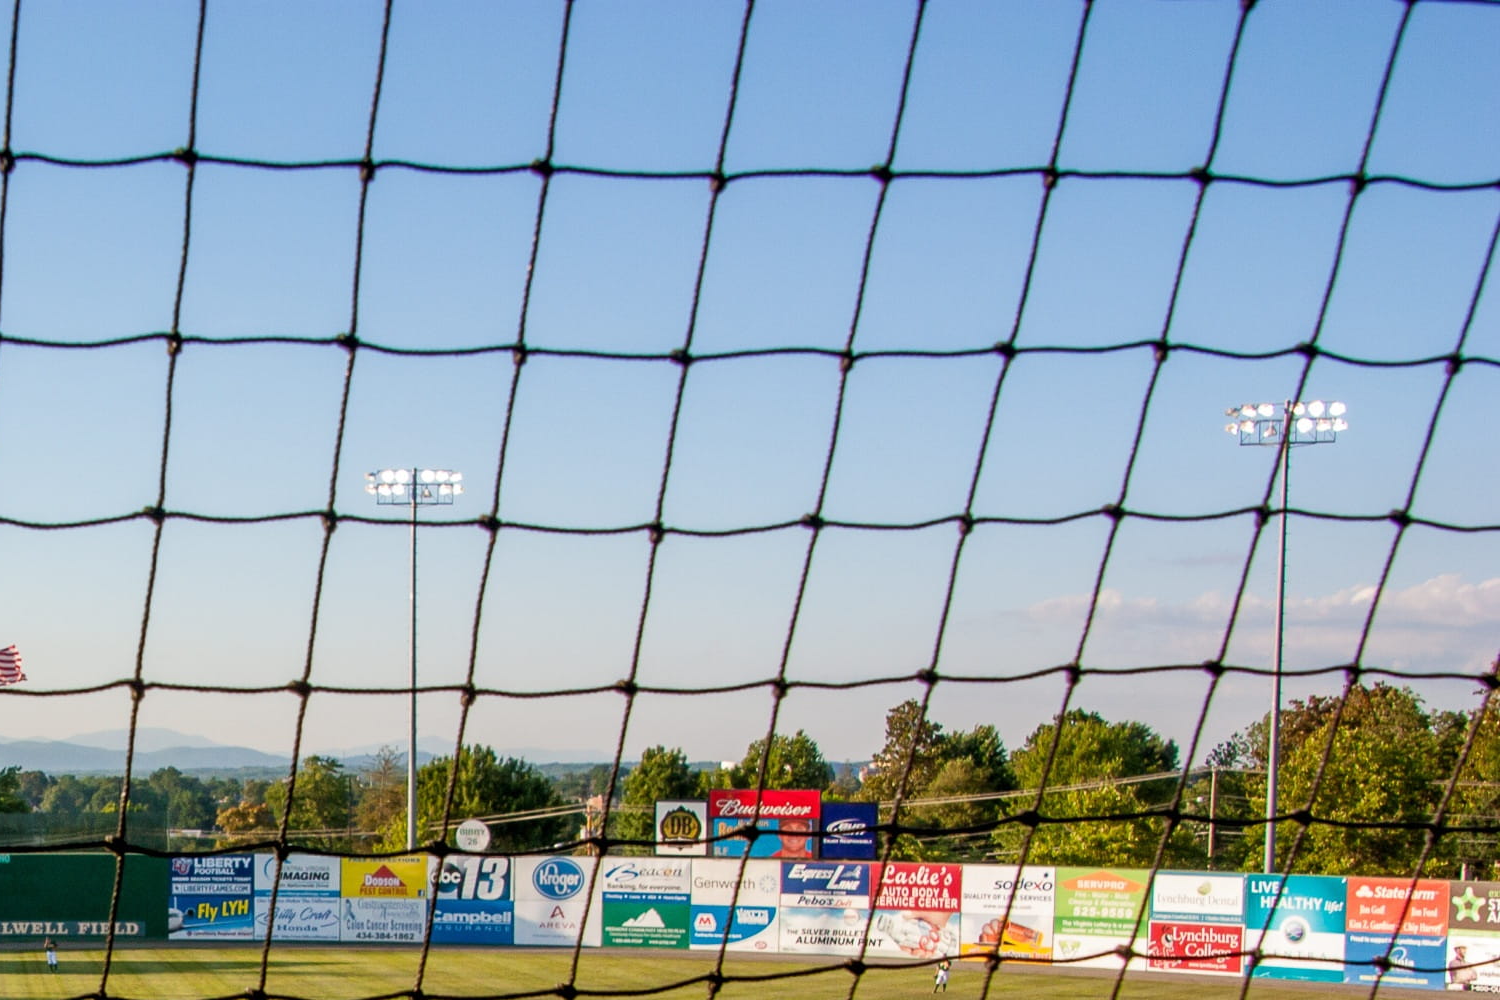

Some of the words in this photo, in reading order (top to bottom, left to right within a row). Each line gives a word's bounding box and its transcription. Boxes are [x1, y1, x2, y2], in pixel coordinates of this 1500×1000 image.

[715, 799, 812, 817] Budweiser
[669, 815, 694, 835] DB
[194, 857, 252, 869] LIBERTY
[194, 868, 235, 876] FOOTBALL
[461, 856, 509, 901] 13
[539, 863, 580, 895] Kroger
[882, 865, 953, 887] Laslie's
[694, 877, 756, 889] Genwoth
[1077, 879, 1126, 890] SERVPRO
[1251, 880, 1280, 894] LIVE
[881, 886, 910, 898] AUTO
[911, 887, 940, 899] BODY
[918, 897, 958, 909] CENTER
[1157, 894, 1205, 907] Lynchburg
[1208, 896, 1238, 905] Dental
[197, 902, 219, 923] Fly
[221, 899, 249, 917] LYH
[433, 909, 512, 925] Campbell
[277, 924, 318, 932] Honda
[366, 919, 389, 930] Cancer
[390, 919, 423, 935] Screening
[832, 929, 865, 937] BULLET
[795, 936, 855, 946] ALUMINUM
[1172, 926, 1239, 948] Lynchburg
[1184, 943, 1232, 963] College
